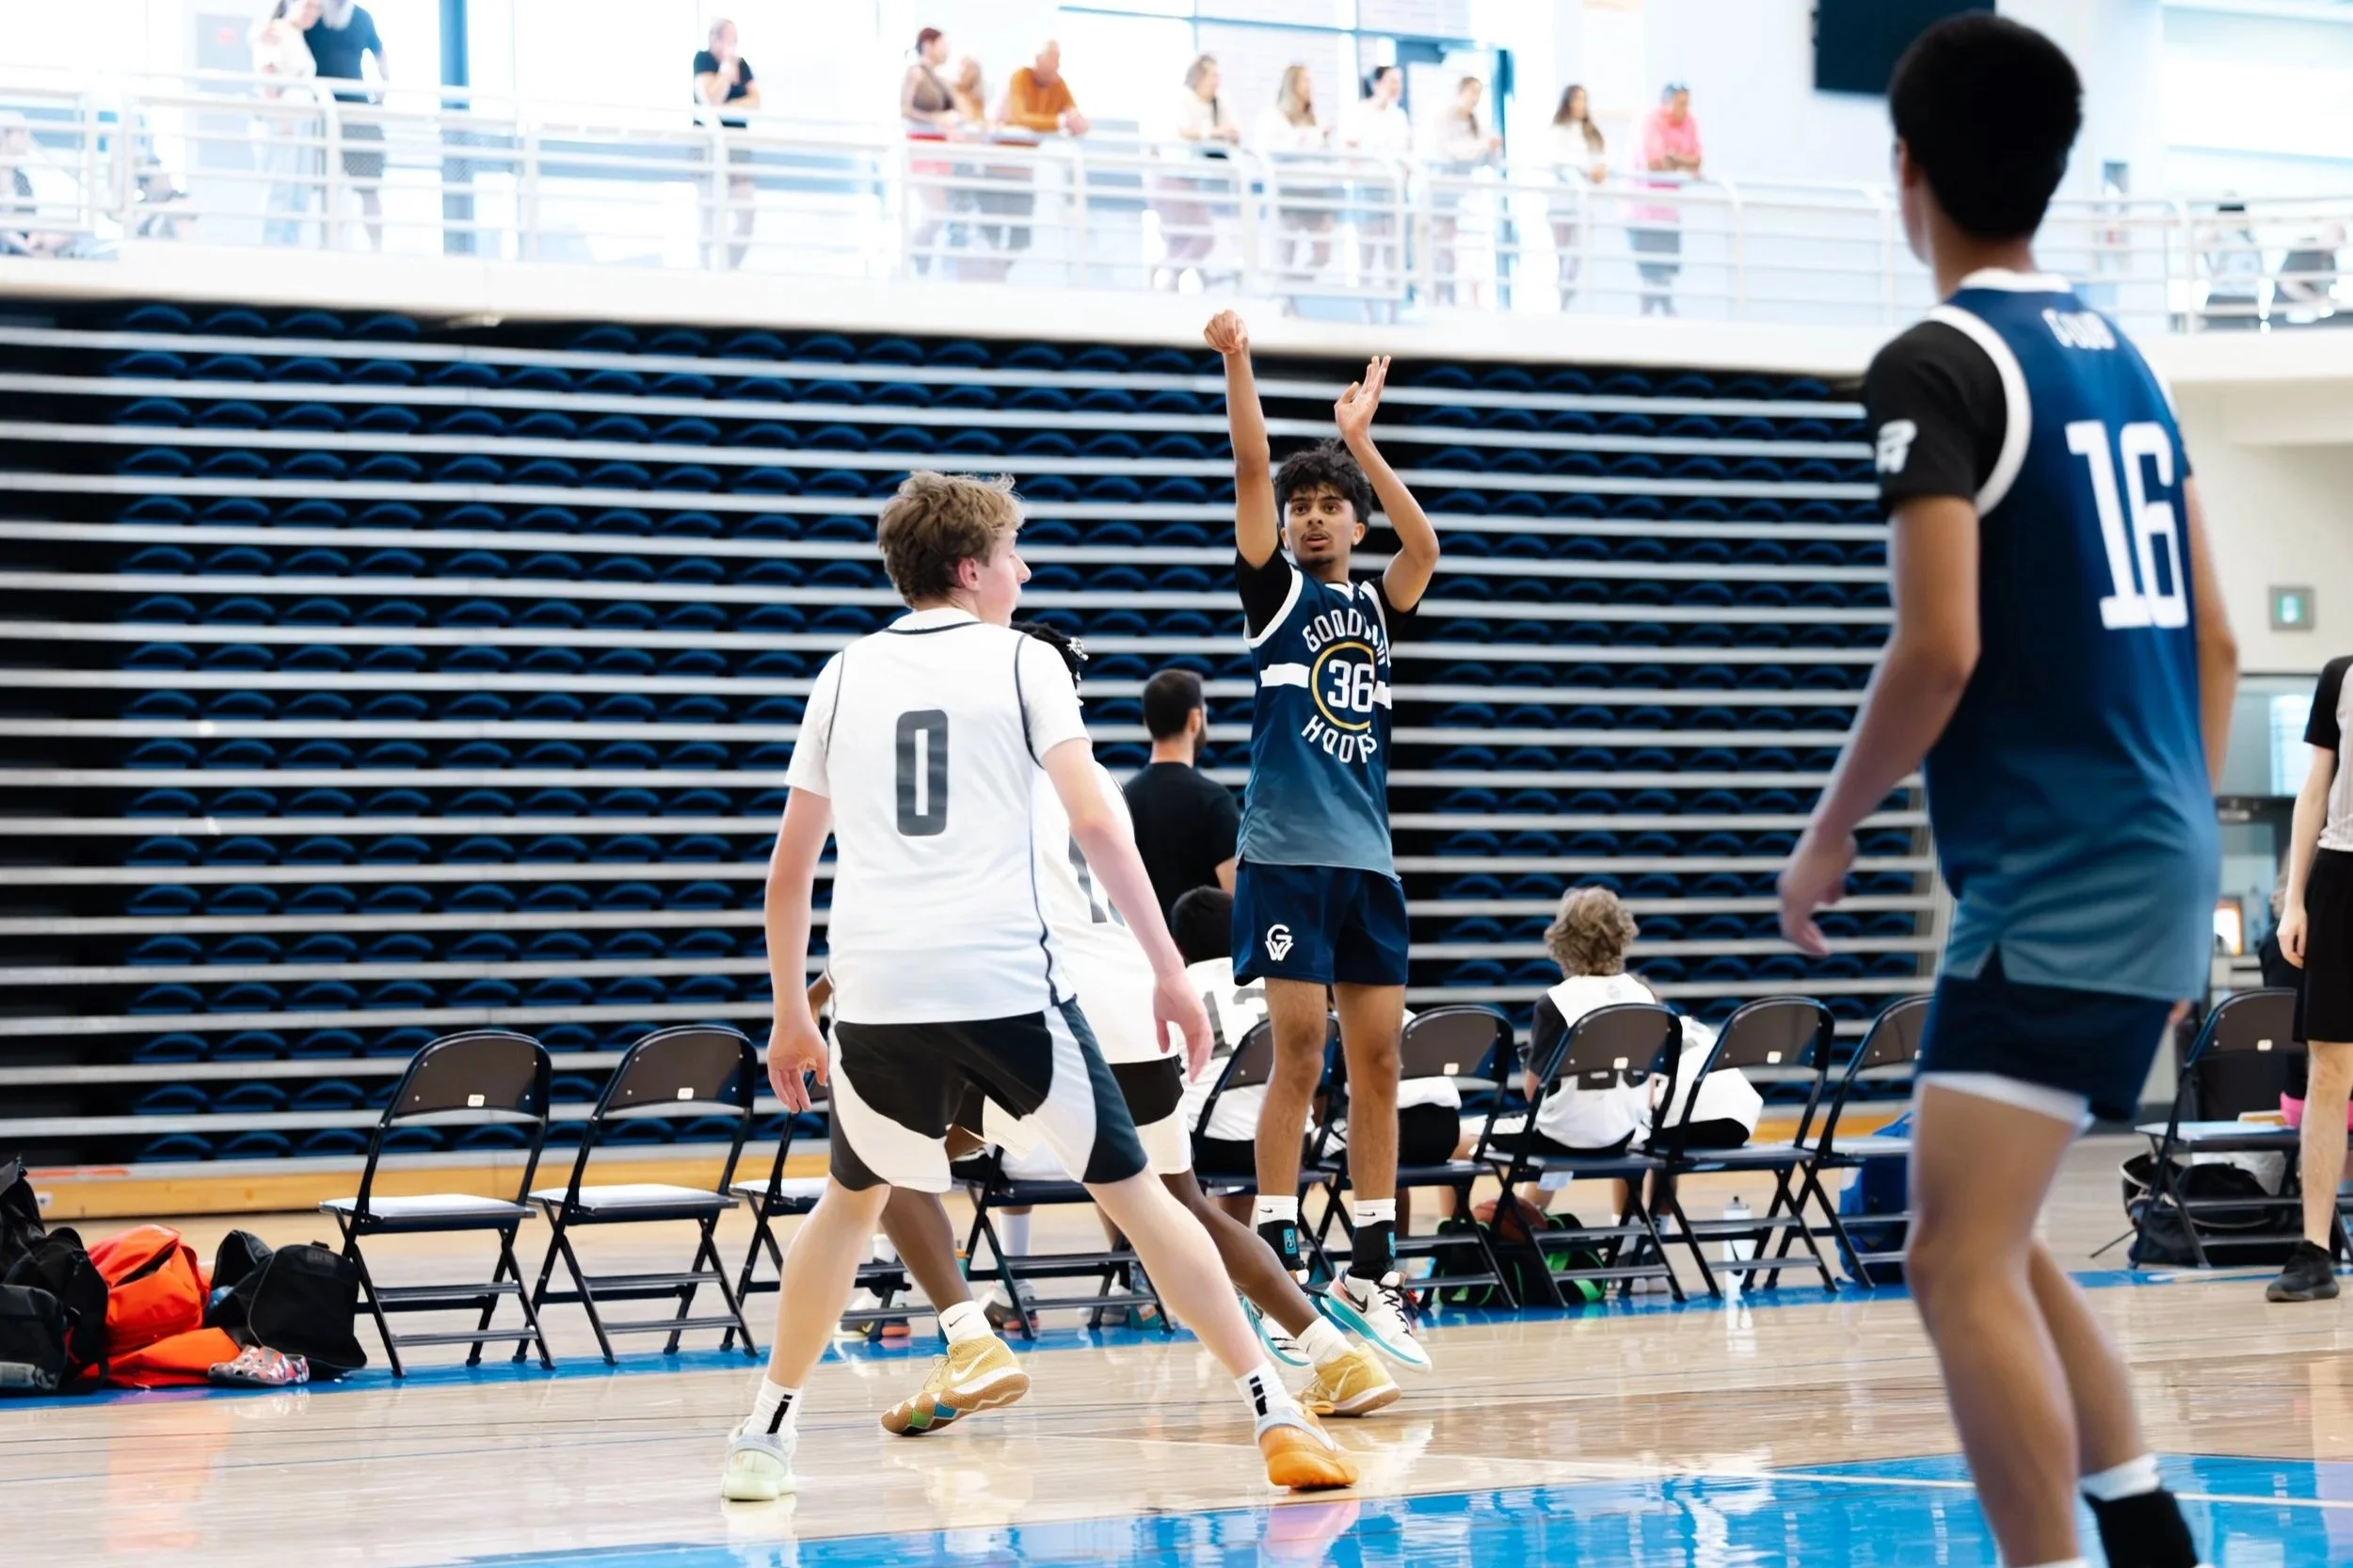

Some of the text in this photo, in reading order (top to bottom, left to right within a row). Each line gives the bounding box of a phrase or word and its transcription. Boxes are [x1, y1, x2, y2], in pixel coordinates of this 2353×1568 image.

[2065, 420, 2188, 629] 16
[1327, 659, 1375, 712] 36
[896, 709, 949, 837] 0
[1302, 714, 1378, 763] HOOP
